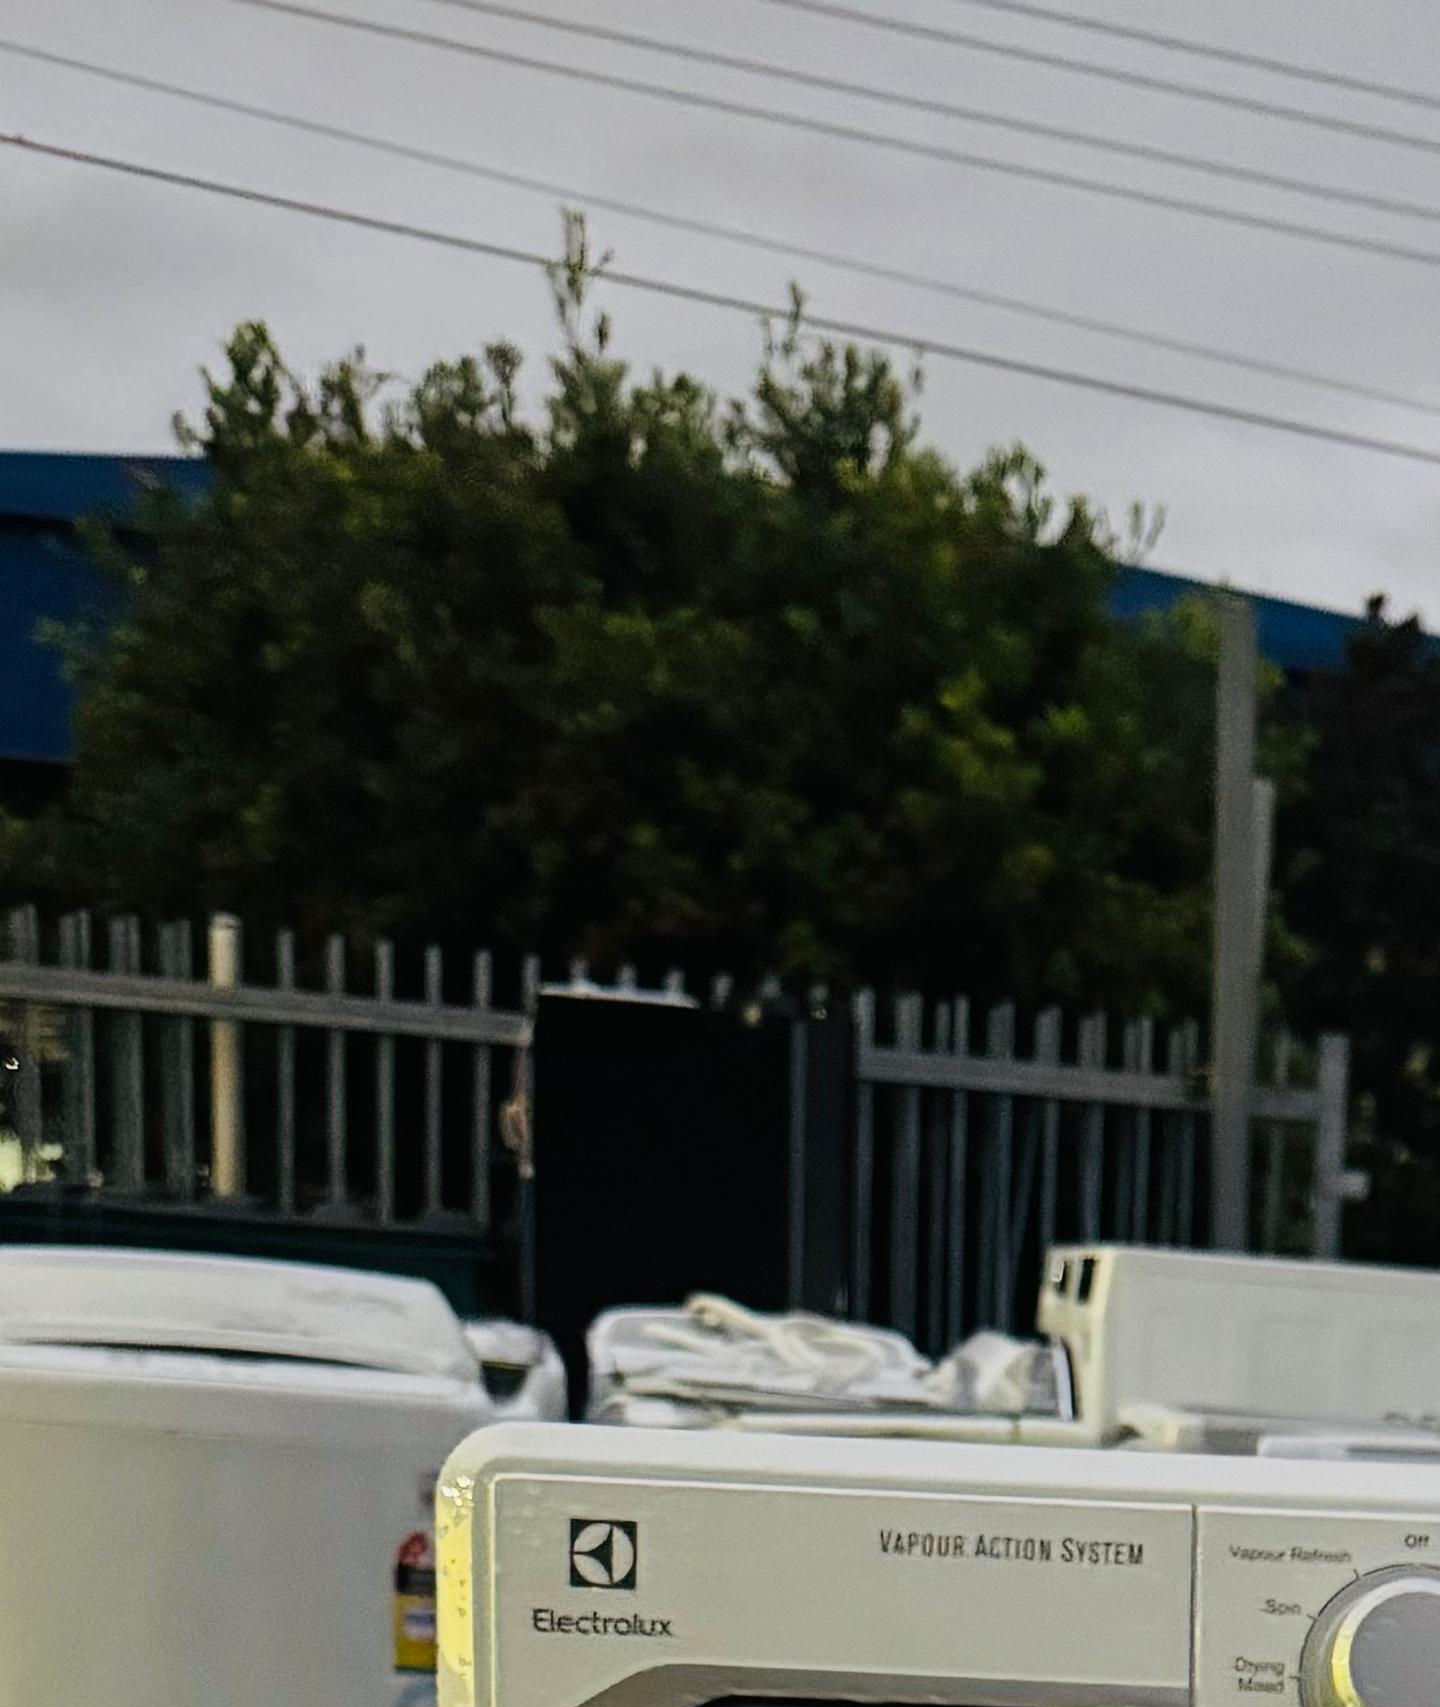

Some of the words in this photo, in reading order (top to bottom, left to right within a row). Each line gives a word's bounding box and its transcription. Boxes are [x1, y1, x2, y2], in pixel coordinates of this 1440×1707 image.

[880, 1530, 964, 1558] VAPOUR
[974, 1534, 1051, 1562] ACTION
[1060, 1538, 1144, 1566] SYSTEM
[1404, 1534, 1429, 1549] Off
[1229, 1545, 1285, 1562] Vapour
[1264, 1599, 1302, 1616] Spin
[532, 1607, 672, 1638] Electrolux
[1236, 1656, 1285, 1677] Drying
